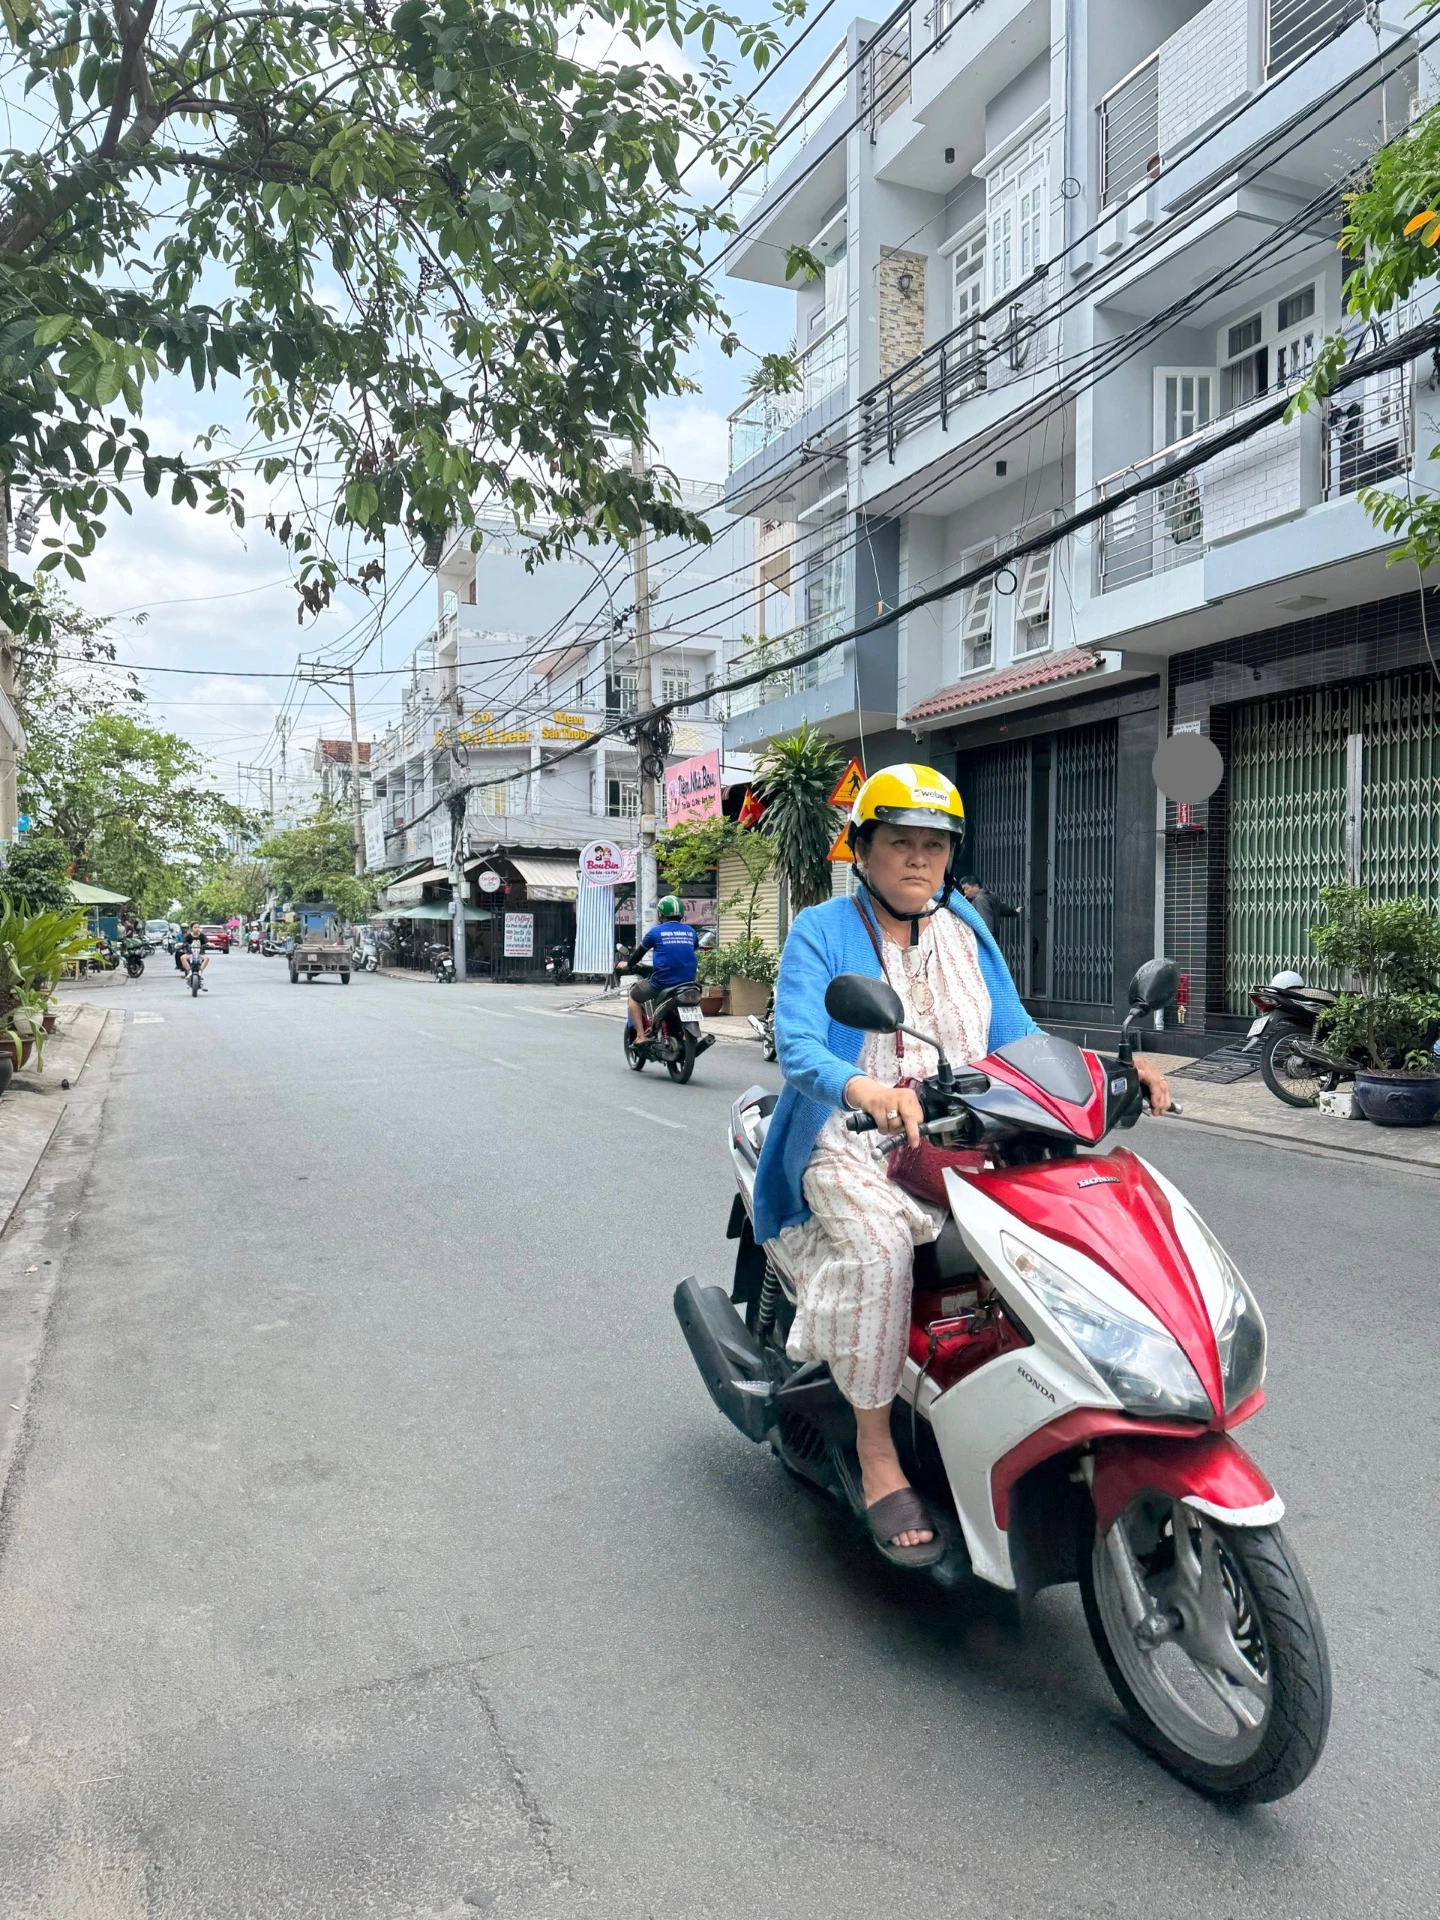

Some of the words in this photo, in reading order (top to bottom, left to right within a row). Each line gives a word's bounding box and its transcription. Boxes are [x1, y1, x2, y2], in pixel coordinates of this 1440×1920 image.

[553, 711, 584, 725] View
[921, 789, 948, 801] weber
[586, 860, 620, 871] BouBin
[1017, 1365, 1056, 1404] HONDA
